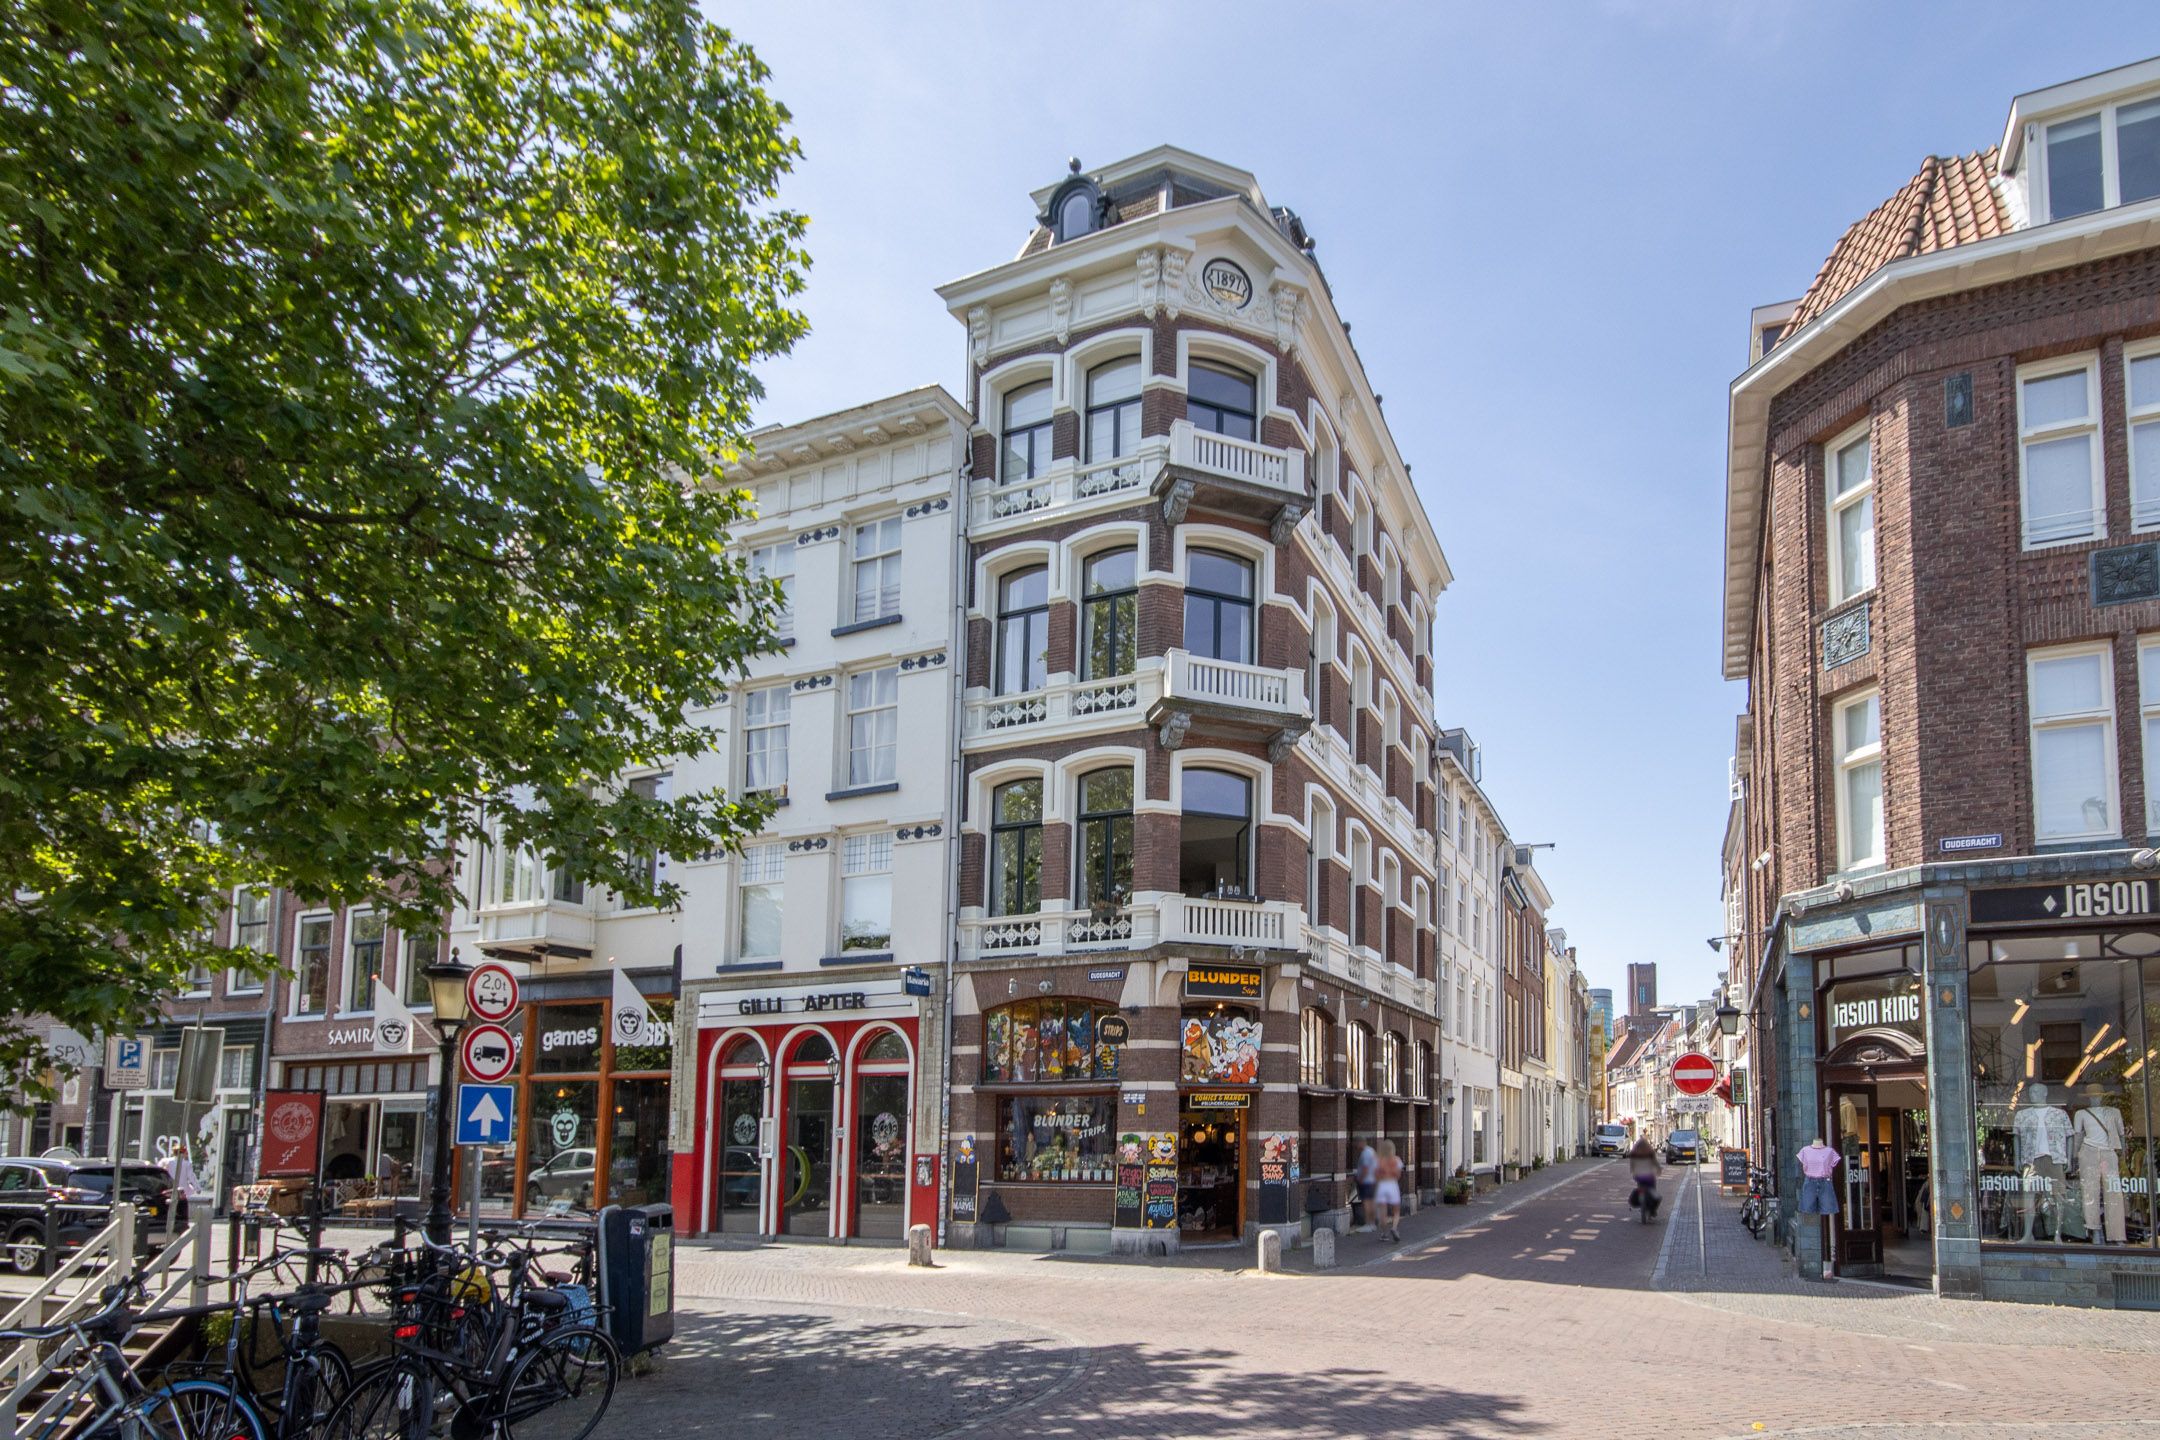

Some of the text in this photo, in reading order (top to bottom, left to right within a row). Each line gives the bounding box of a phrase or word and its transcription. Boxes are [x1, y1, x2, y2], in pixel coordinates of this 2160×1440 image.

[1216, 271, 1243, 291] 1897
[1945, 837, 1998, 848] OUDEGRACHT
[907, 975, 930, 987] Bavaria
[1188, 971, 1261, 986] BLUNDER
[739, 997, 782, 1015] GILLI
[1103, 1024, 1123, 1037] STRIPS
[542, 1027, 598, 1051] games
[124, 1042, 137, 1057] P
[1033, 1113, 1091, 1128] BLUNDER
[1078, 1123, 1107, 1140] STRIPS
